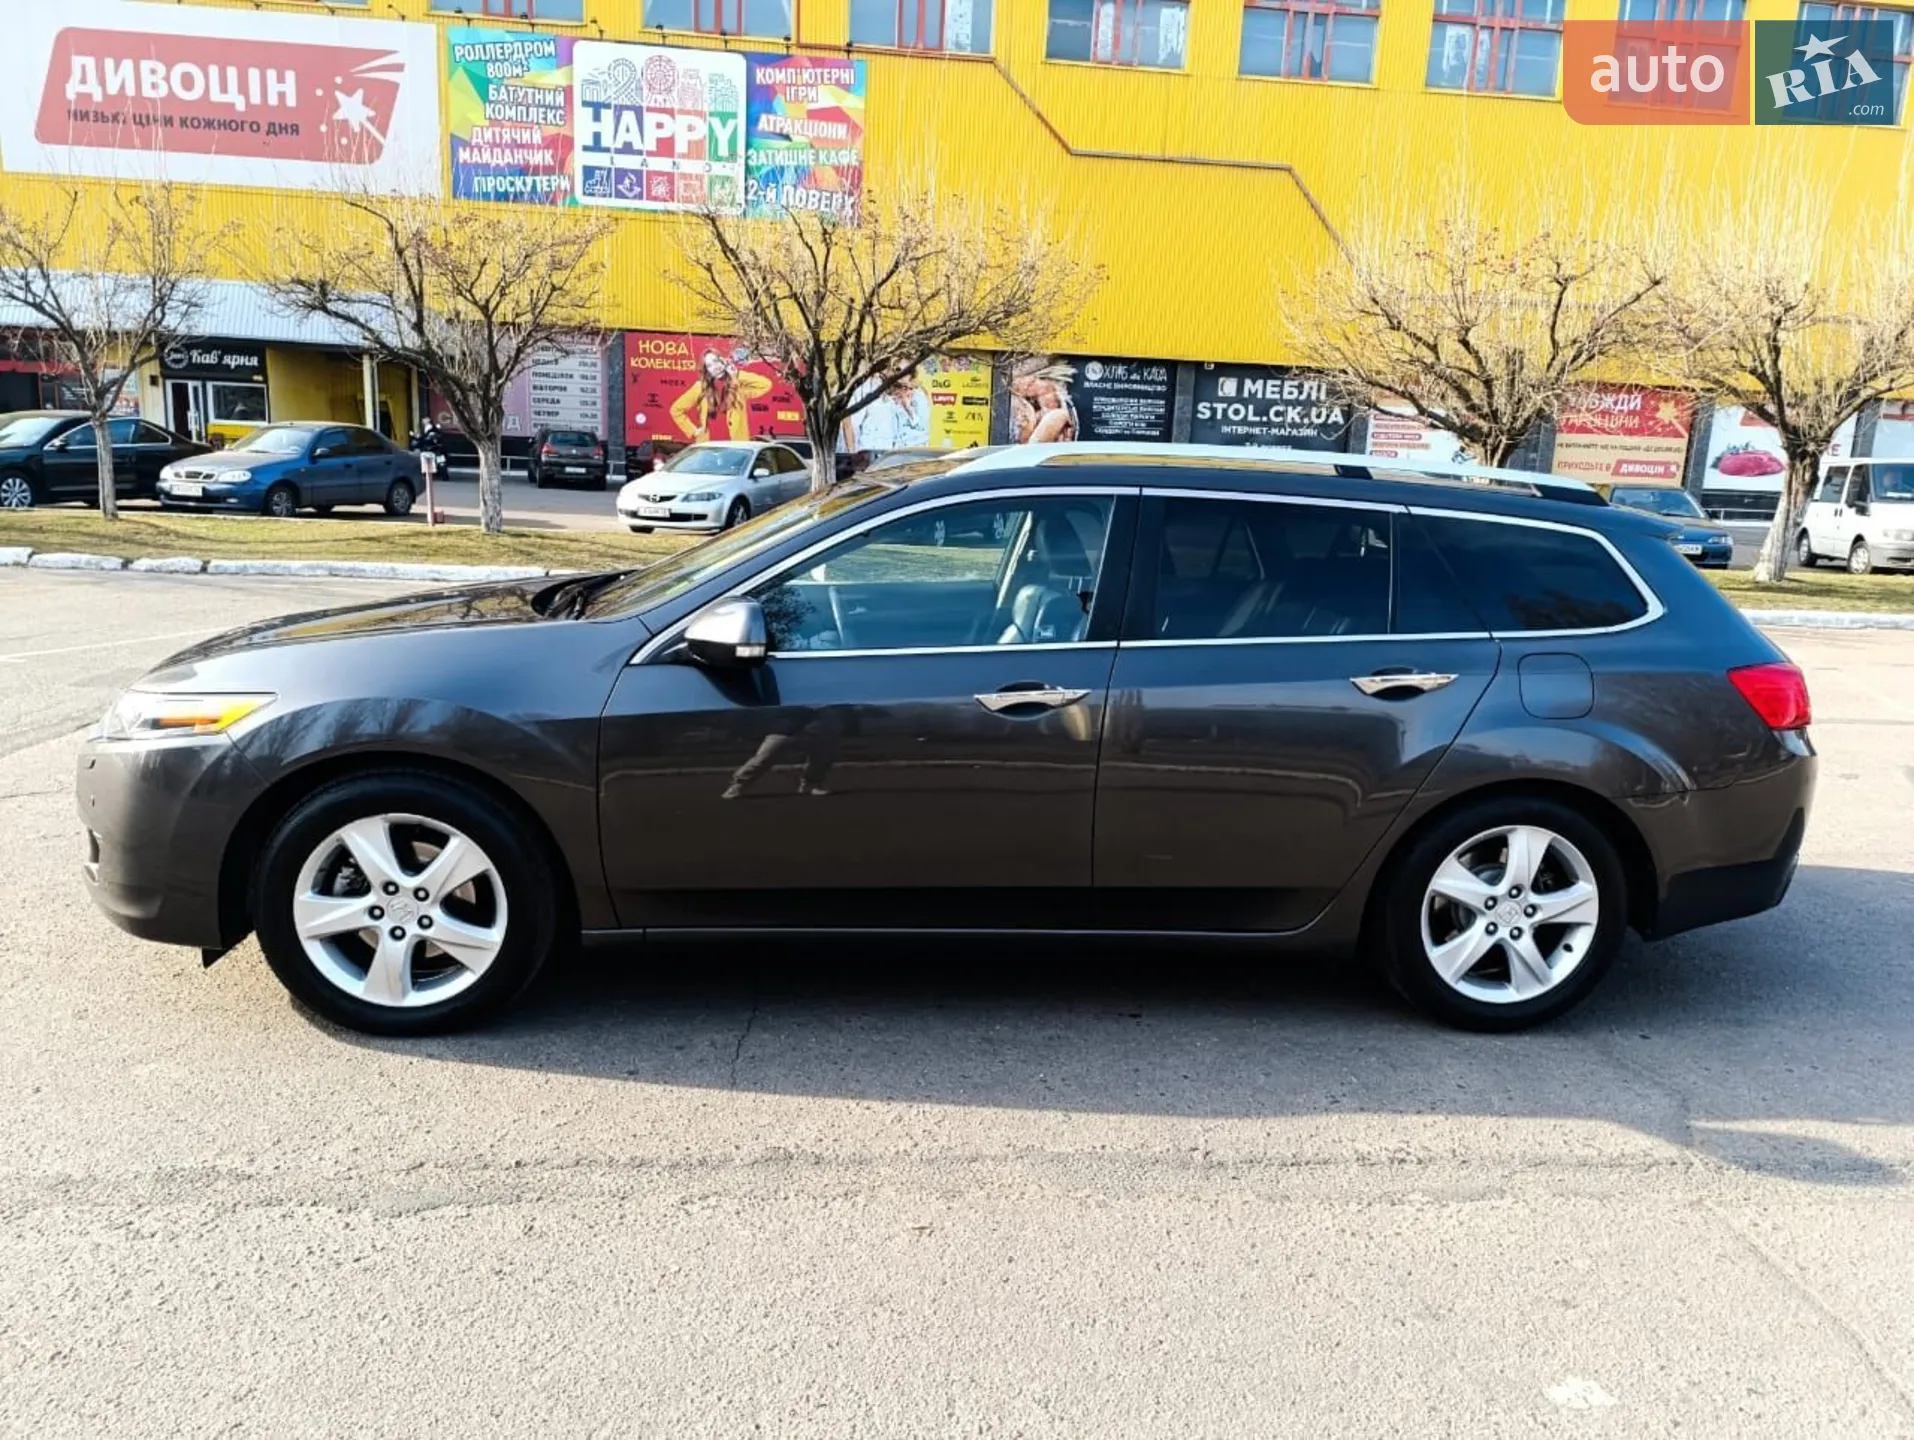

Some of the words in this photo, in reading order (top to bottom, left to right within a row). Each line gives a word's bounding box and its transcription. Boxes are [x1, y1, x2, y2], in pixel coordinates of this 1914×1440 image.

[454, 39, 556, 63] РОЛЛЕРДРОМ
[65, 55, 297, 111] ДИВОЦІН
[786, 85, 819, 103] ІГРИ
[488, 85, 565, 107] БАТУТНИЙ
[132, 115, 174, 128] ЦІНИ
[179, 117, 261, 133] КОЖНОГО
[267, 121, 300, 137] ДНЯ
[485, 104, 565, 126] КОМПЛЕКС
[757, 112, 847, 139] АТРАКЦІОНИ
[471, 126, 542, 147] ДИТЯЧИЙ
[582, 100, 737, 162] HAPPY
[459, 144, 555, 166] МАЙДАНЧИК
[748, 149, 816, 167] ЗАТИШНЕ
[819, 150, 859, 167] КАФЕ
[473, 175, 571, 193] ГІРОСКУТЕРИ
[638, 339, 689, 356] НОВА
[630, 356, 697, 371] КОЛЕКЦІЯ
[1243, 378, 1328, 401] МЕБЛІ
[532, 397, 561, 405] СЕРЕДА
[1196, 401, 1345, 425] STOL.CK.UA
[1221, 425, 1319, 437] ІНТЕРНЕТ-МАГАЗИН
[1619, 463, 1666, 475] ДИВОЦІН
